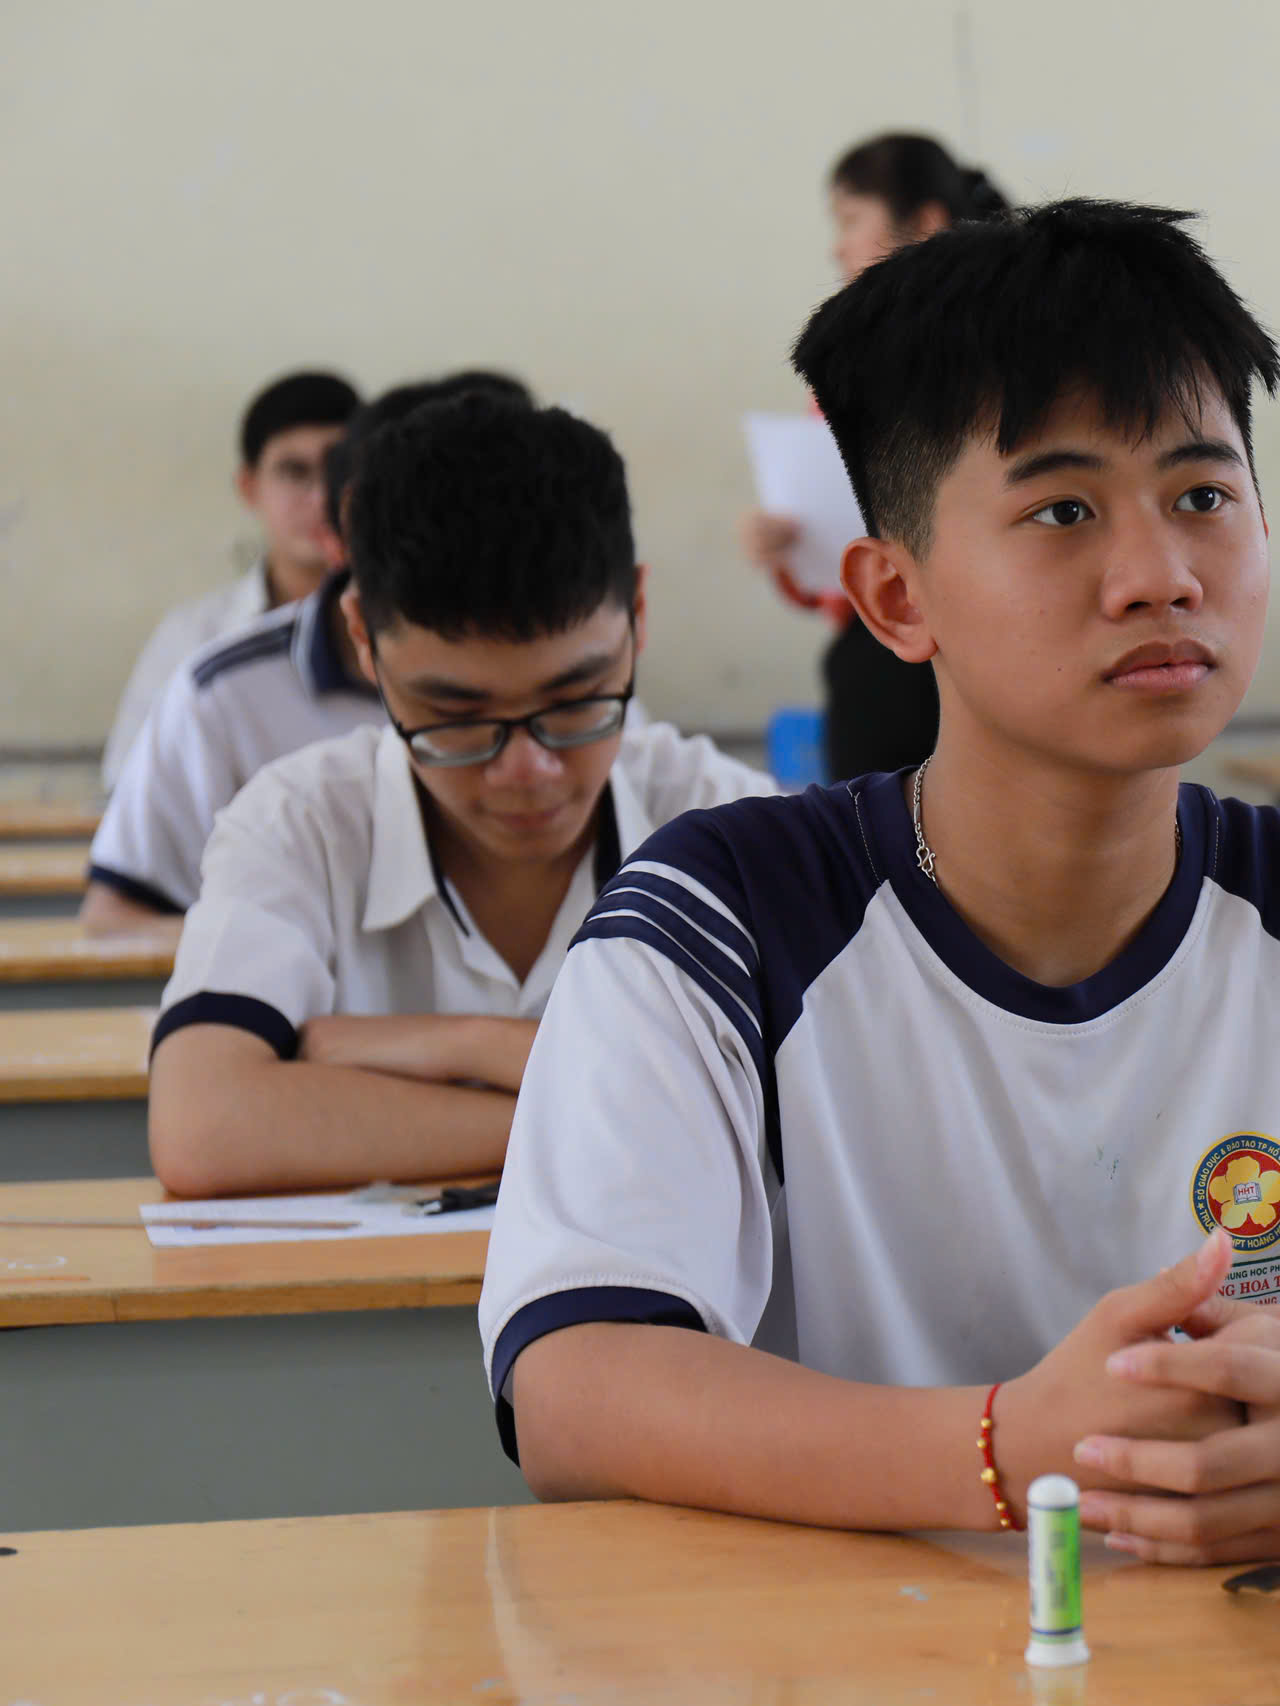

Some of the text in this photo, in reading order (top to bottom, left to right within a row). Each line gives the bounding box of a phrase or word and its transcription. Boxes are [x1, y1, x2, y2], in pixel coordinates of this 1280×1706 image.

[1257, 1141, 1267, 1150] TP
[1237, 1186, 1255, 1196] HHT
[1239, 1279, 1270, 1294] HOA
